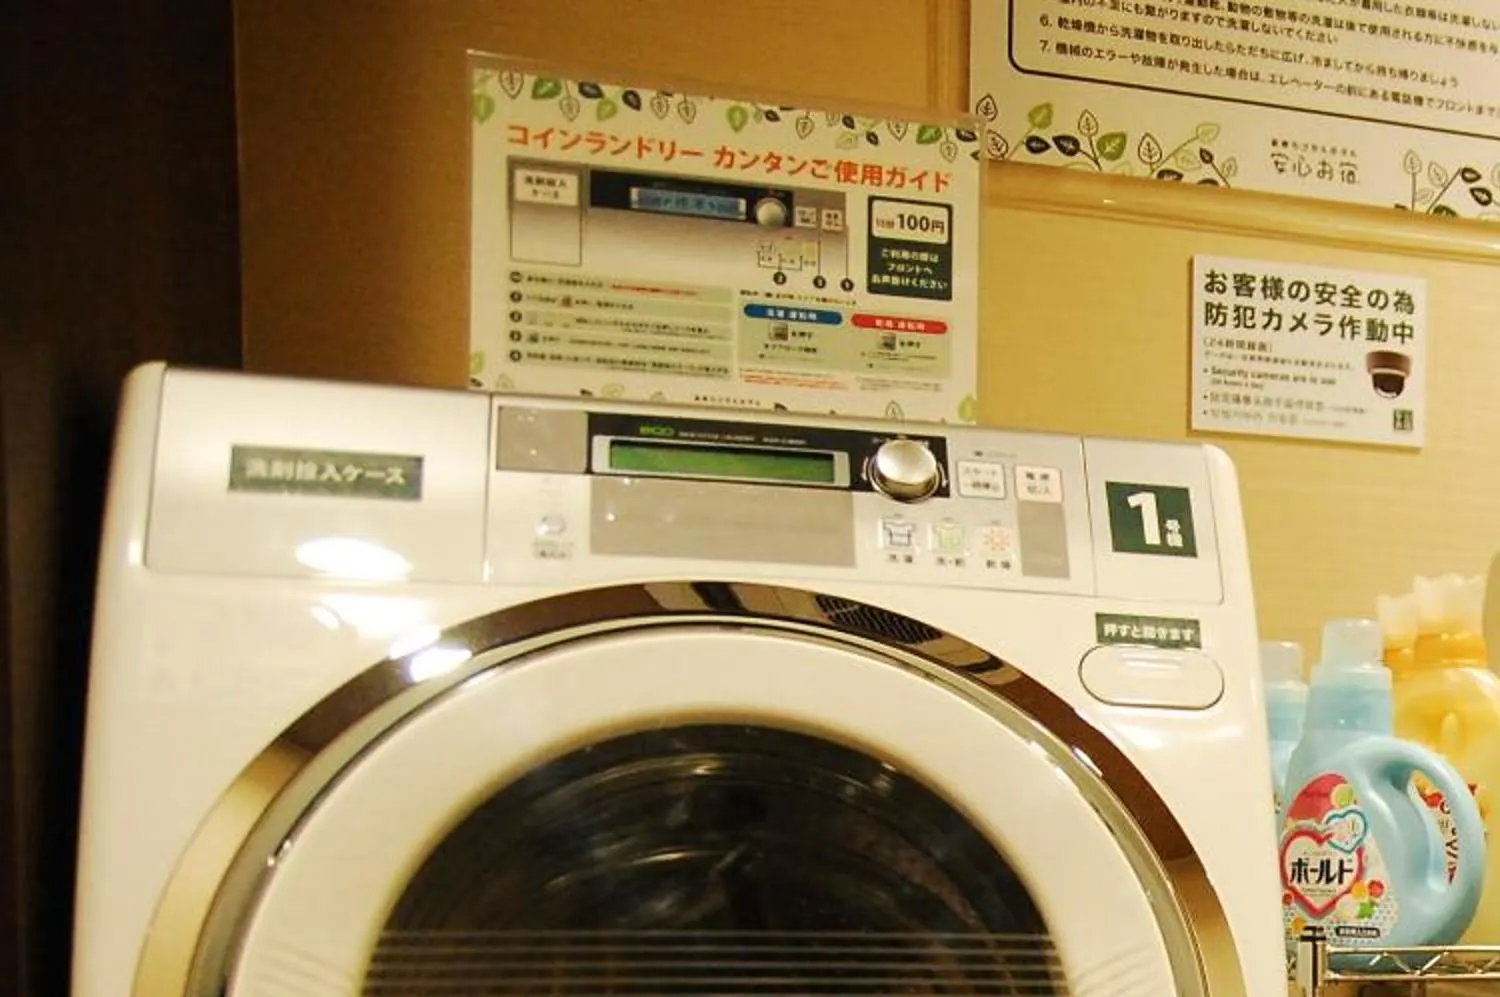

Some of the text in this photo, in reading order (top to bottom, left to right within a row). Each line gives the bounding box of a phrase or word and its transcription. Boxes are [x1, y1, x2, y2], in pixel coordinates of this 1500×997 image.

[507, 124, 951, 193] コインランドリー カンタンご使用ガイド
[1203, 268, 1416, 316] お客様の安全の為
[1203, 300, 1416, 346] 防犯カメラ作動中
